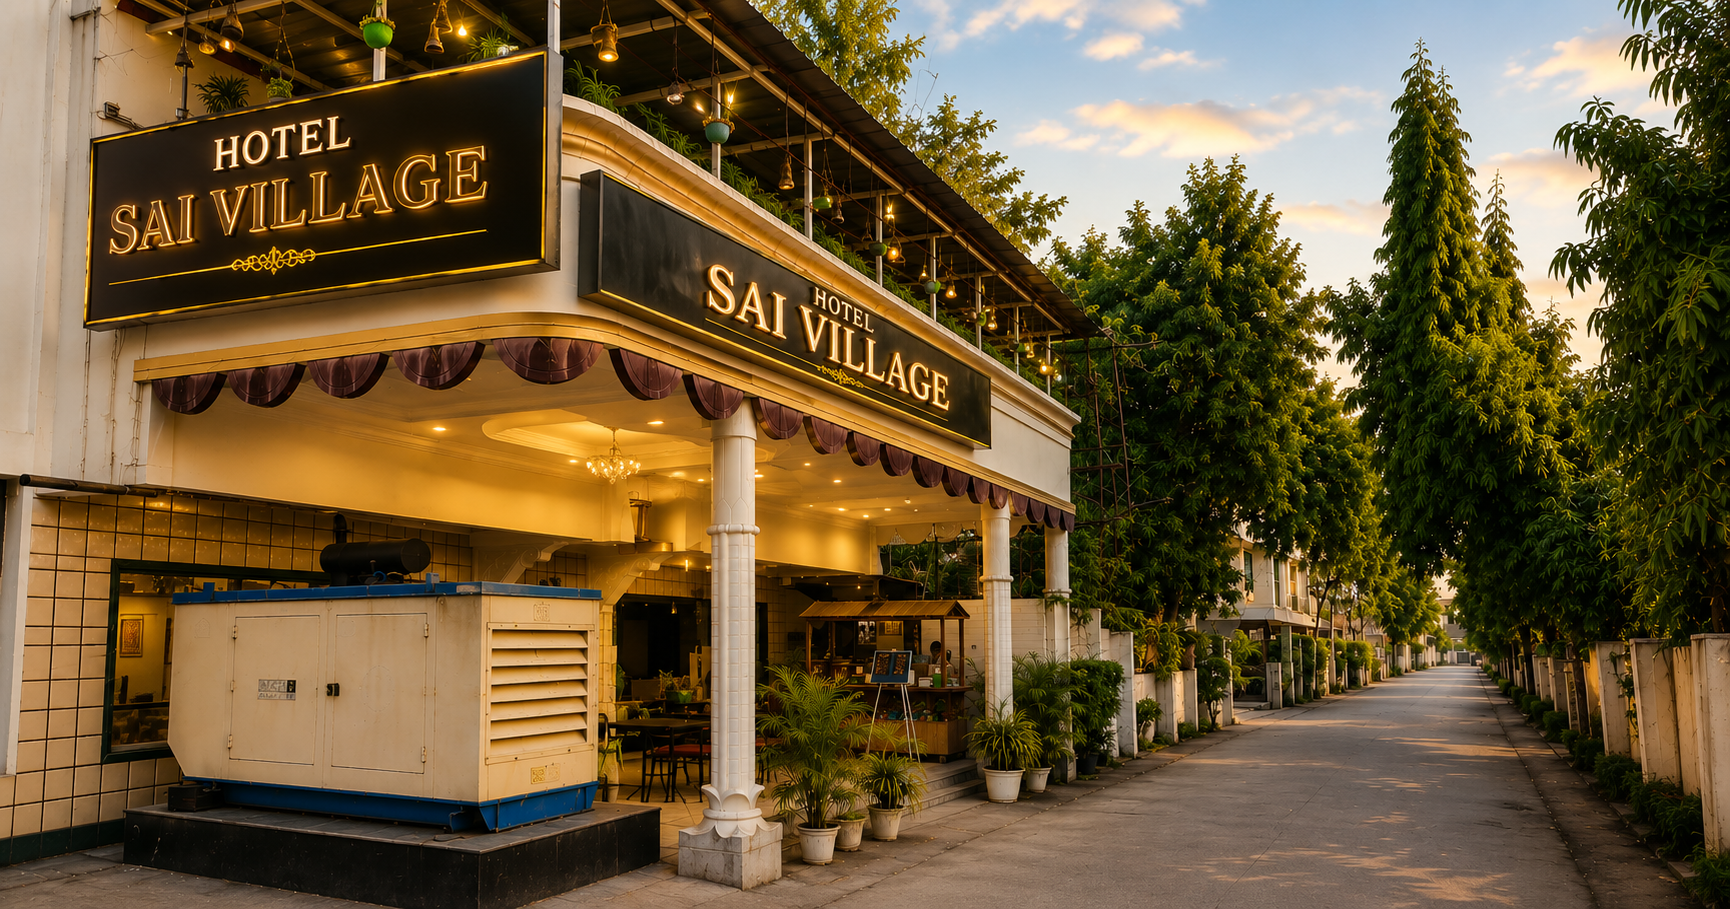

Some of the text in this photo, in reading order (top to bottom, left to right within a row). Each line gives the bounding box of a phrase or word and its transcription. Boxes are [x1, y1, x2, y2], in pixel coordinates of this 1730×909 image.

[213, 115, 351, 172] HOTEL
[109, 145, 489, 255] SAI VILLAGE
[706, 263, 950, 411] SAI VILLAGE
[813, 286, 875, 333] HOTEL
